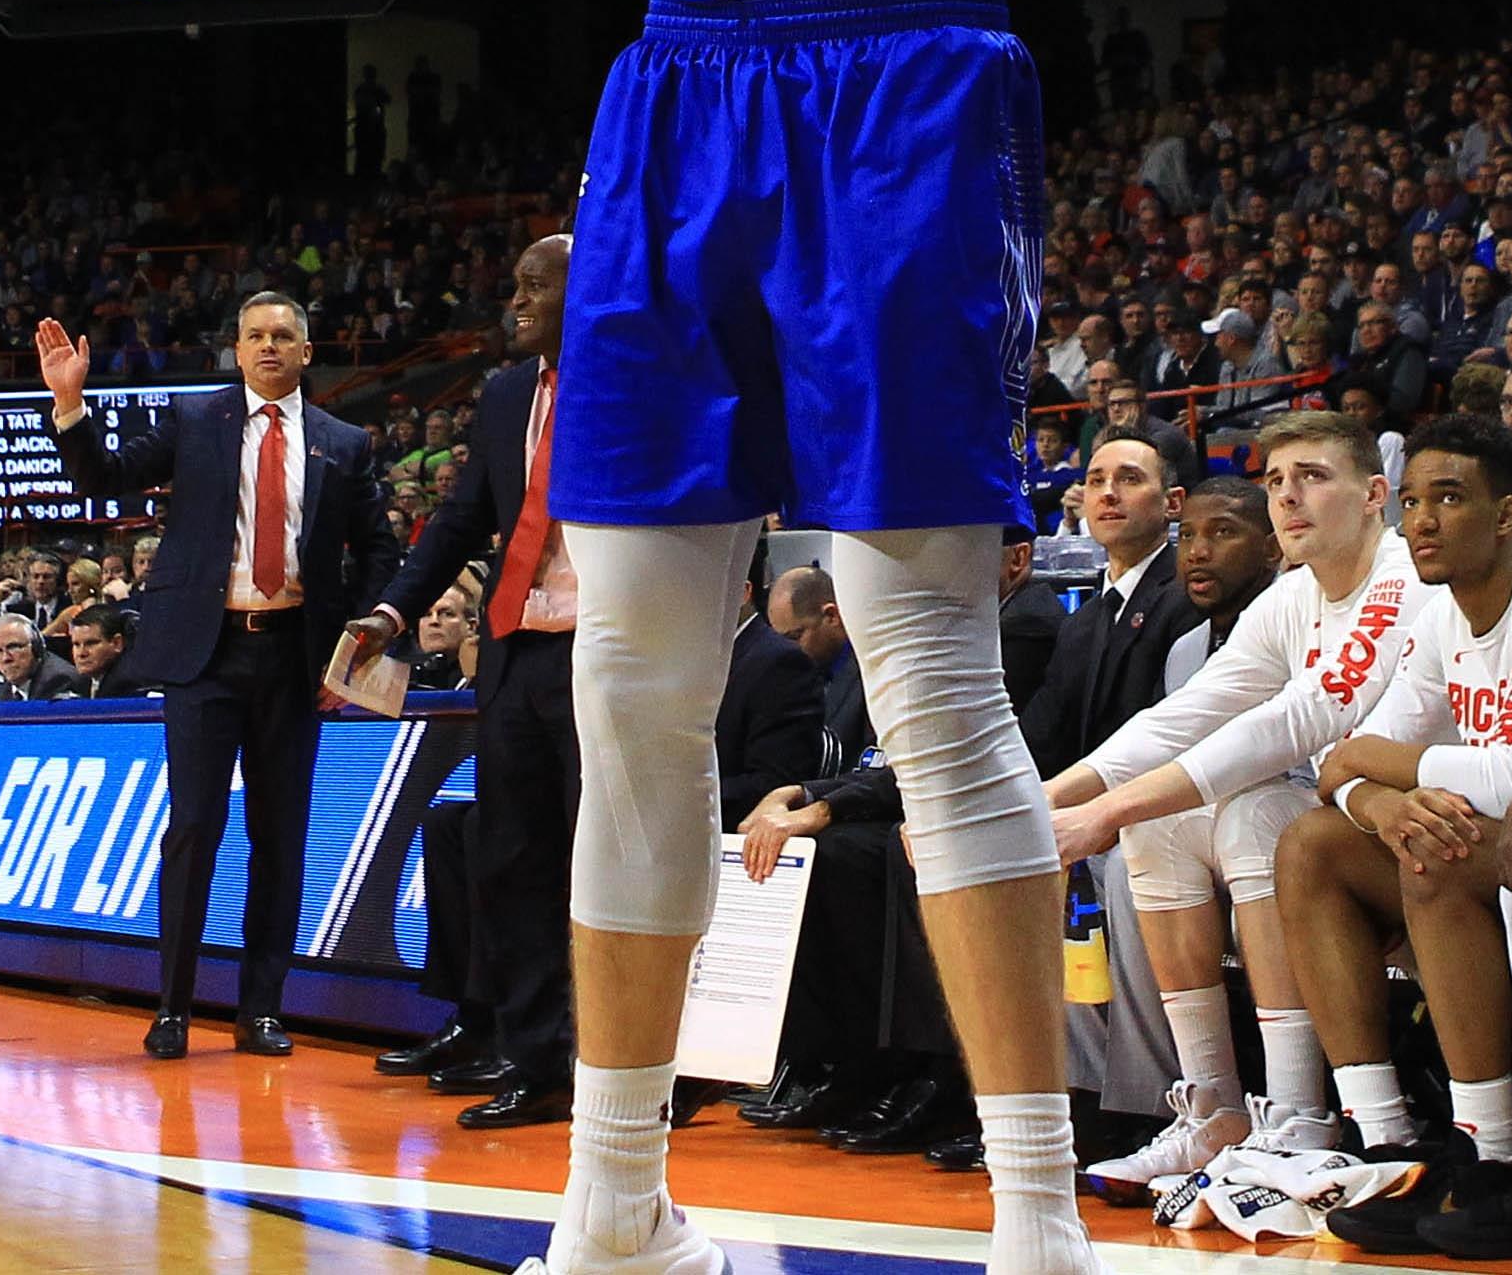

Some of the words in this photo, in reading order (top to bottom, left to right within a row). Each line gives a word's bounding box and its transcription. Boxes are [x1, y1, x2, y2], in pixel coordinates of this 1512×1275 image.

[6, 413, 43, 430] TATE
[10, 435, 57, 453] JACK
[6, 457, 62, 475] DAKICH
